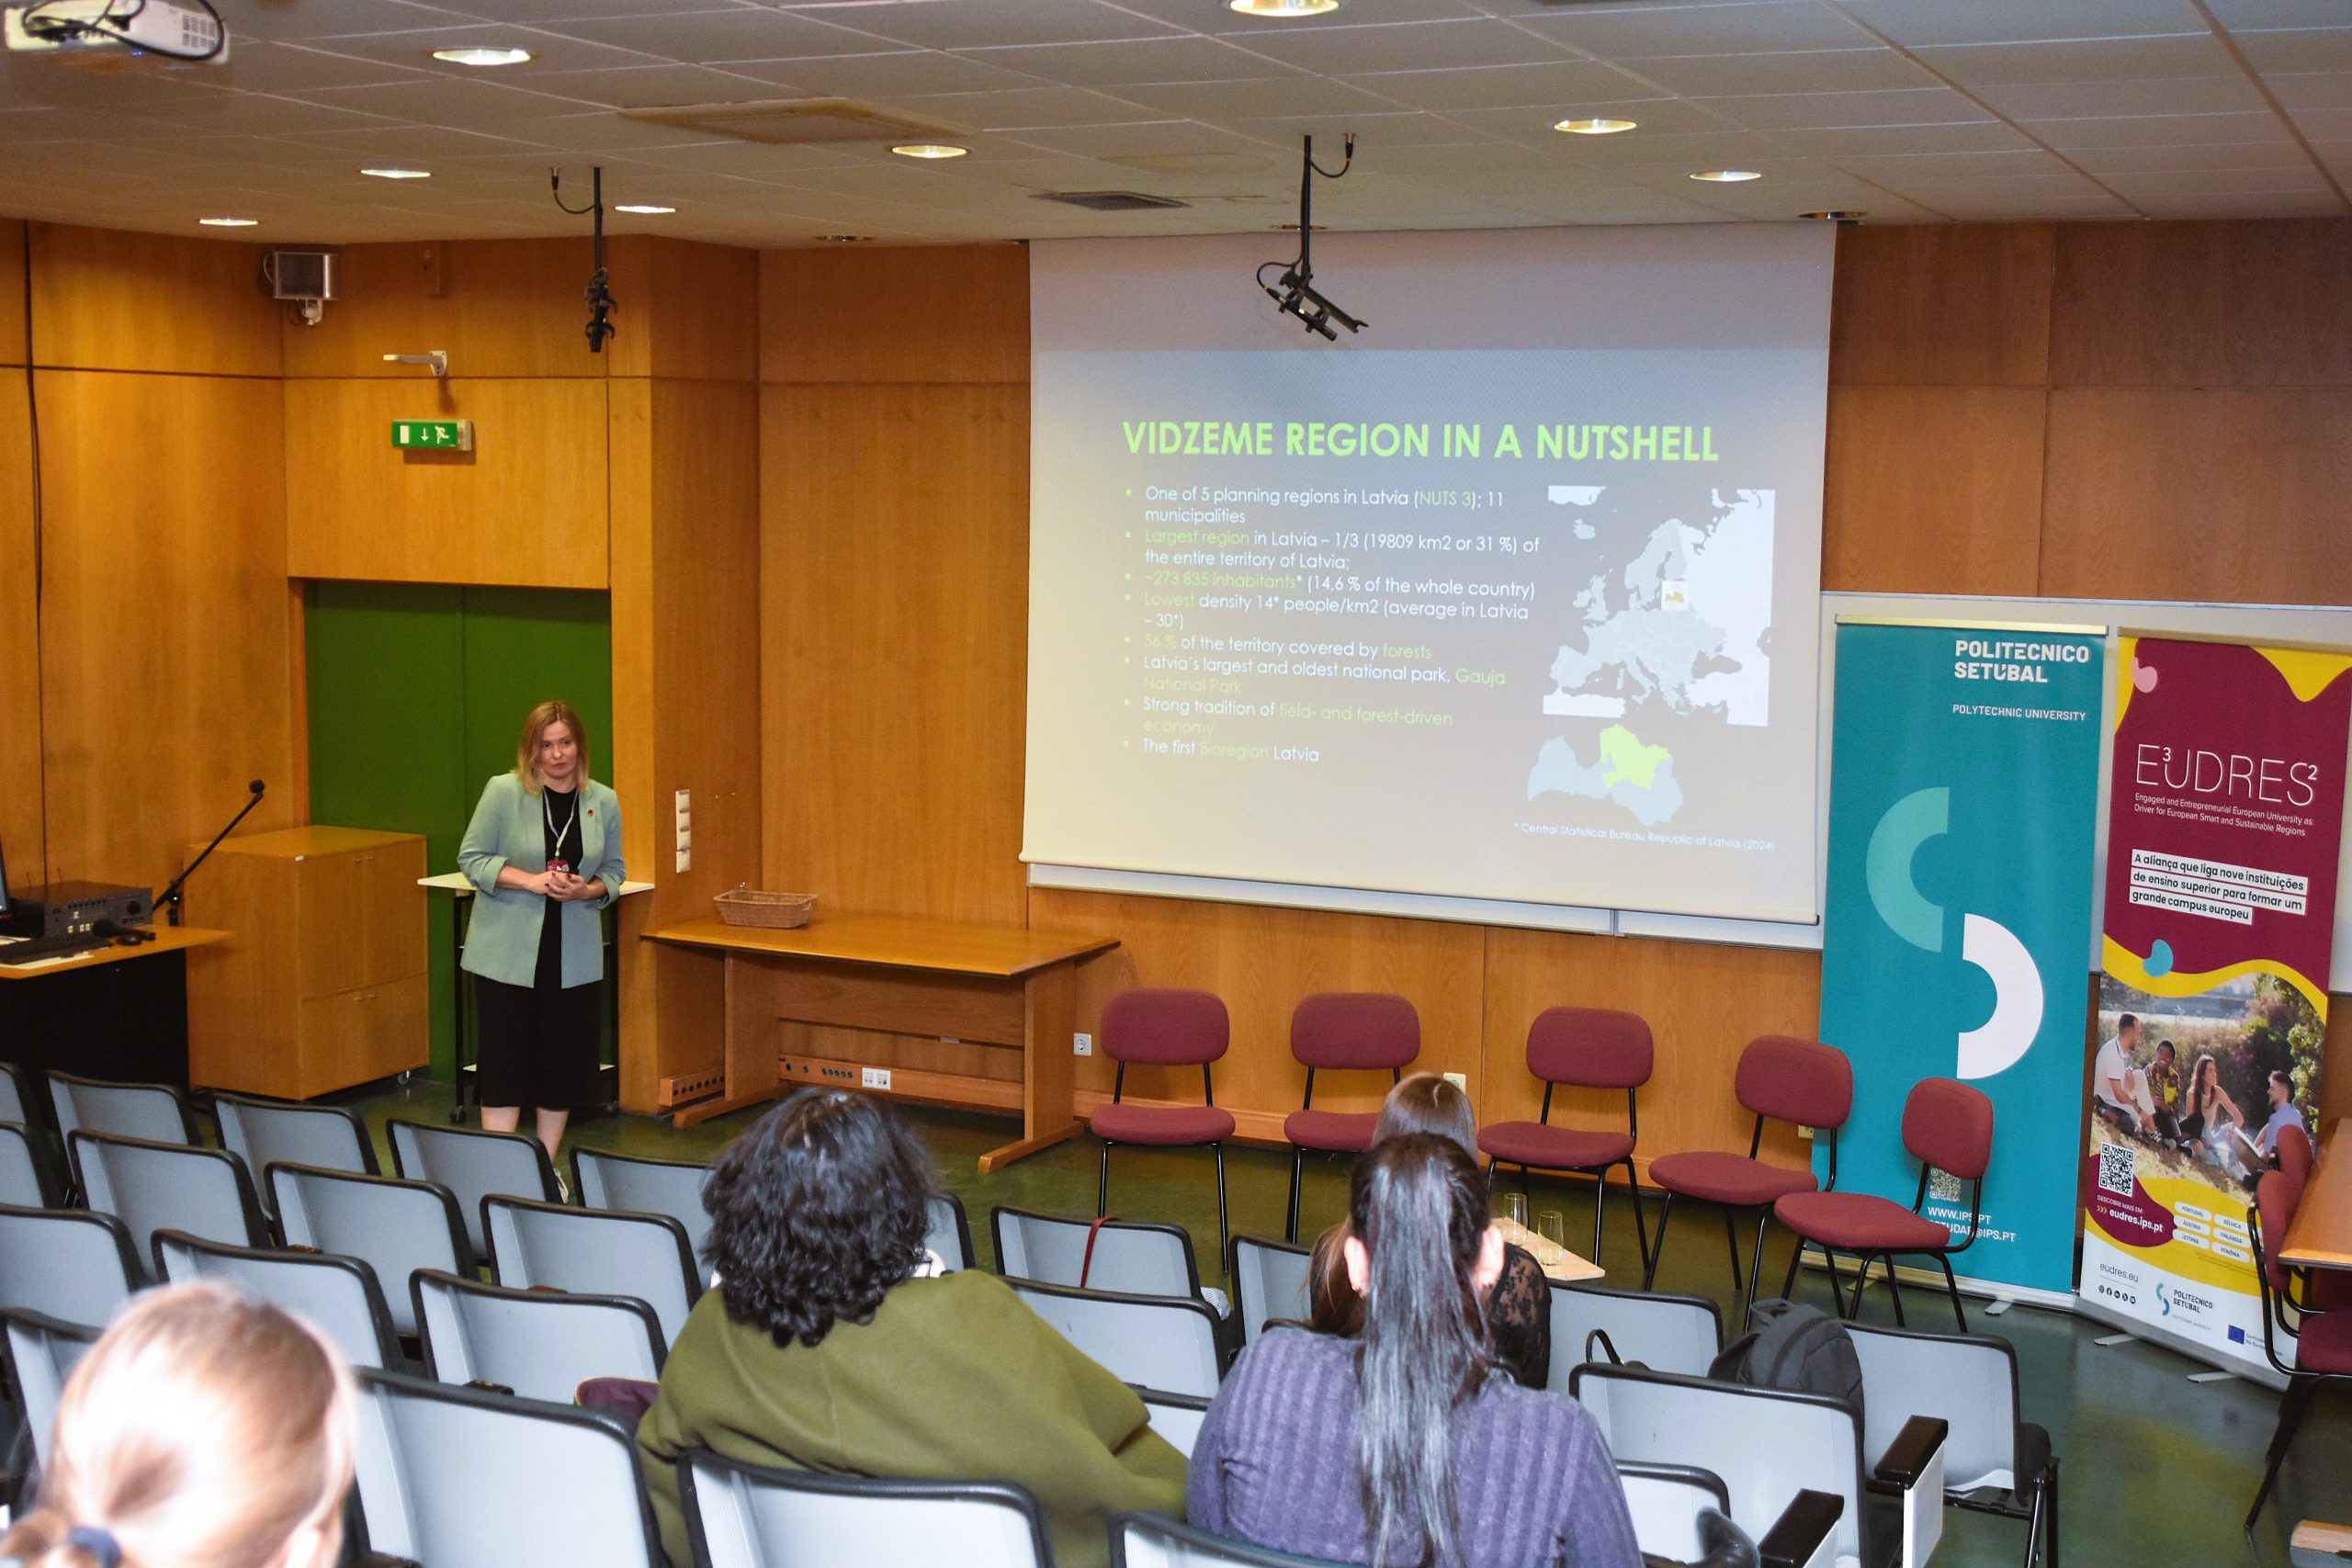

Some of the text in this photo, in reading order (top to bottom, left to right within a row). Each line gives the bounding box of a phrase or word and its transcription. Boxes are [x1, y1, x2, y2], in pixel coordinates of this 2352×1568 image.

[1123, 422, 1719, 462] VIDZEME REGION IN A NUTSHELL
[1146, 486, 1503, 510] One of 5 planning regions in Latvia (NUTS 3); 11
[1146, 508, 1245, 525] municipalities
[1146, 528, 1198, 546] Largest
[1202, 530, 1250, 547] region
[1254, 531, 1266, 545] in
[1272, 531, 1317, 547] Latvia
[1335, 533, 1359, 548] 1/3
[1364, 533, 1414, 551] (19809
[1419, 535, 1451, 550] km2
[1456, 538, 1471, 551] or
[1476, 536, 1492, 551] 31
[1499, 537, 1517, 555] %)
[1523, 537, 1541, 552] of
[1146, 549, 1351, 571] the entire territory of Latvia;
[1183, 571, 1209, 587] 835
[1348, 577, 1360, 592] %
[1365, 577, 1380, 592] of
[1385, 578, 1410, 592] the
[1415, 580, 1463, 595] whole
[1468, 581, 1534, 601] country)
[1145, 592, 1194, 606] Lowest
[1199, 593, 1251, 612] density
[1283, 598, 1379, 615] people/km2
[1385, 599, 1456, 620] (average
[1462, 603, 1475, 617] in
[1480, 604, 1528, 619] Latvia
[1146, 633, 1160, 648] 56
[1181, 636, 1196, 649] of
[1201, 636, 1224, 650] the
[1229, 637, 1284, 656] territory
[1289, 641, 1354, 657] covered
[1359, 642, 1378, 660] by
[1383, 643, 1432, 660] forests
[1144, 676, 1241, 693] National Park
[1204, 657, 1252, 675] largest
[1257, 660, 1287, 674] and
[1293, 660, 1339, 678] oldest
[1343, 663, 1407, 680] national
[1411, 666, 1450, 683] park,
[1455, 669, 1506, 688] Gauja
[1143, 696, 1453, 726] Strong tradition of field- and forest-driven
[1953, 705, 2086, 721] POLYTECHNIC UNIVERSITY
[1143, 719, 1214, 737] economy
[1143, 739, 1319, 761] The first Bioregion Latvia
[2134, 804, 2305, 837] Driver for European Smart and Sustainable Regions
[2135, 793, 2312, 826] Engaged and Entrepreneurial European University as
[1521, 822, 1558, 836] Central
[1560, 826, 1608, 840] Statistical
[1610, 829, 1645, 841] Bureau
[1647, 832, 1692, 846] Republic
[1709, 837, 1741, 850] Latvia
[2134, 854, 2304, 891] A aliança que liga nove instituições
[2133, 872, 2302, 910] de ensino superior para formar um
[2132, 889, 2249, 920] grande campus europeu
[1928, 1206, 1992, 1224] WWW.IPSPT
[2097, 1194, 2121, 1207] DESCOBRE
[2122, 1202, 2134, 1212] MAIS
[2182, 1206, 2203, 1217] PORTUGAL
[1929, 1220, 2016, 1243] UDA@IPS.PT
[2109, 1209, 2163, 1233] eudres.ips.pt
[2099, 1262, 2139, 1283] eudres.eu
